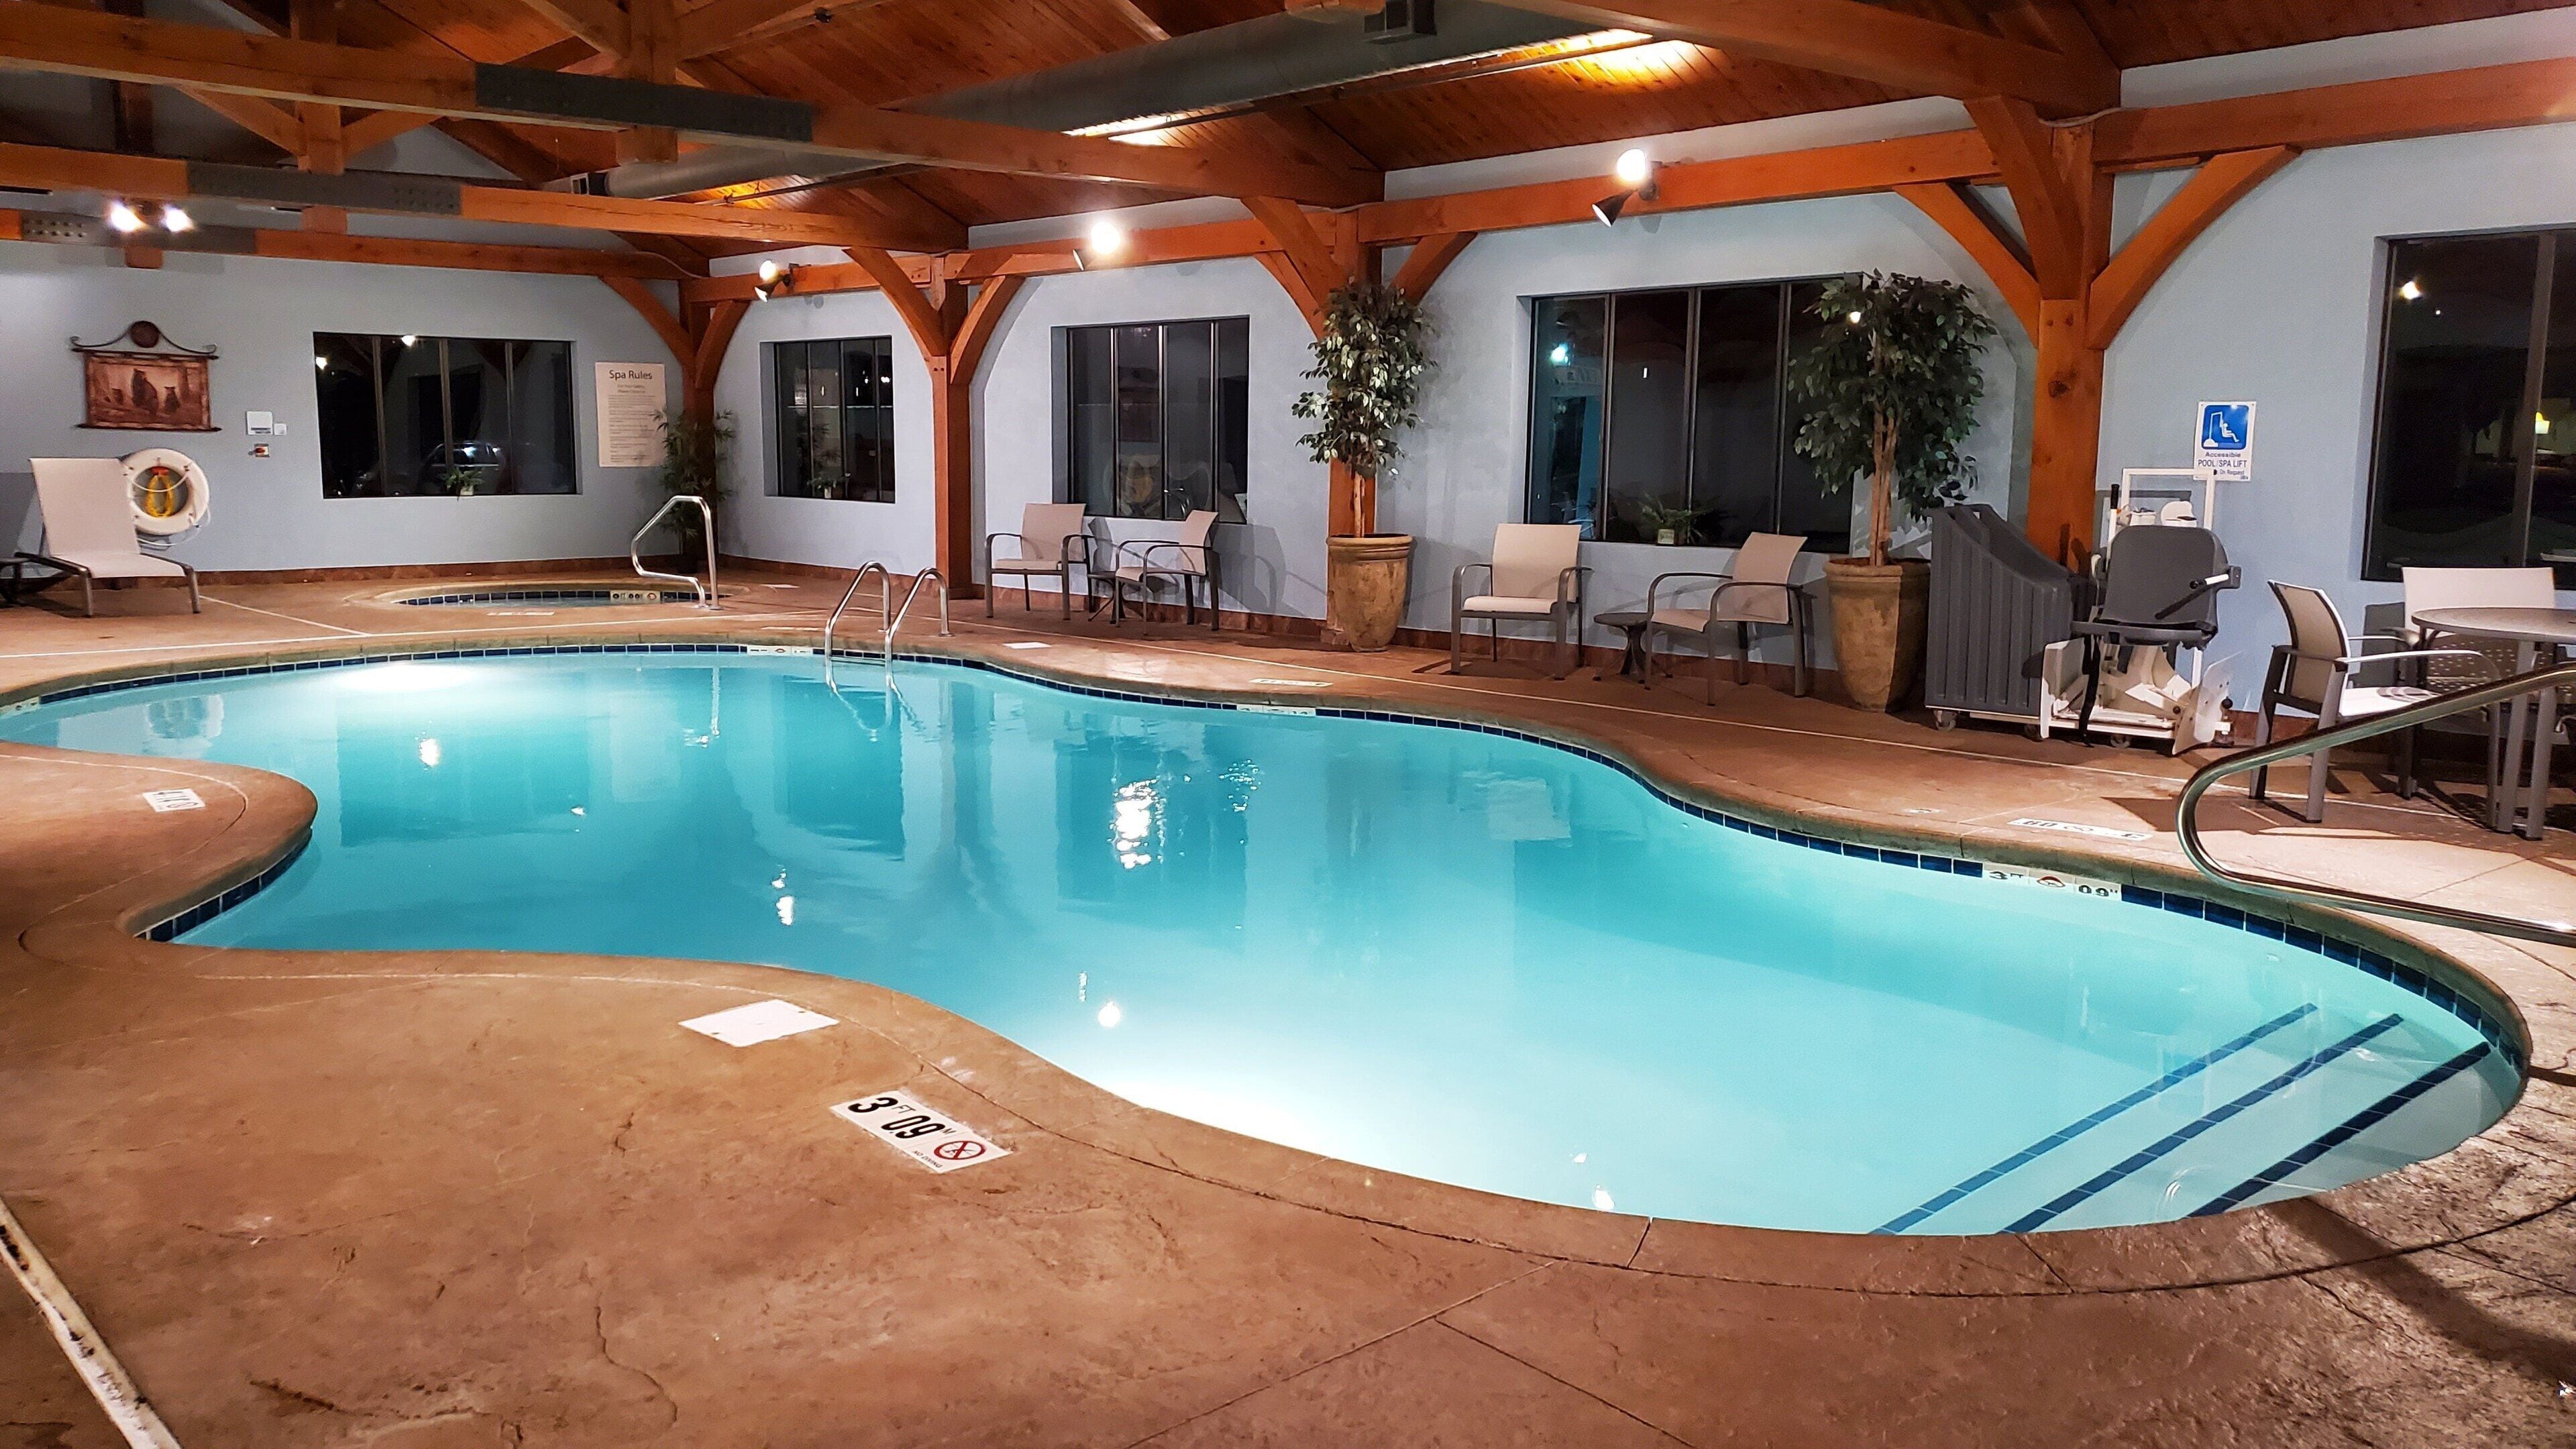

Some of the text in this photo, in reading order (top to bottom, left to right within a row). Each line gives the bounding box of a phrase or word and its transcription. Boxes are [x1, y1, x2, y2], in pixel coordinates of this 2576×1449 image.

[609, 370, 653, 381] Spa Rules
[1989, 871, 2008, 880] 3
[848, 1097, 916, 1114] 3 FT
